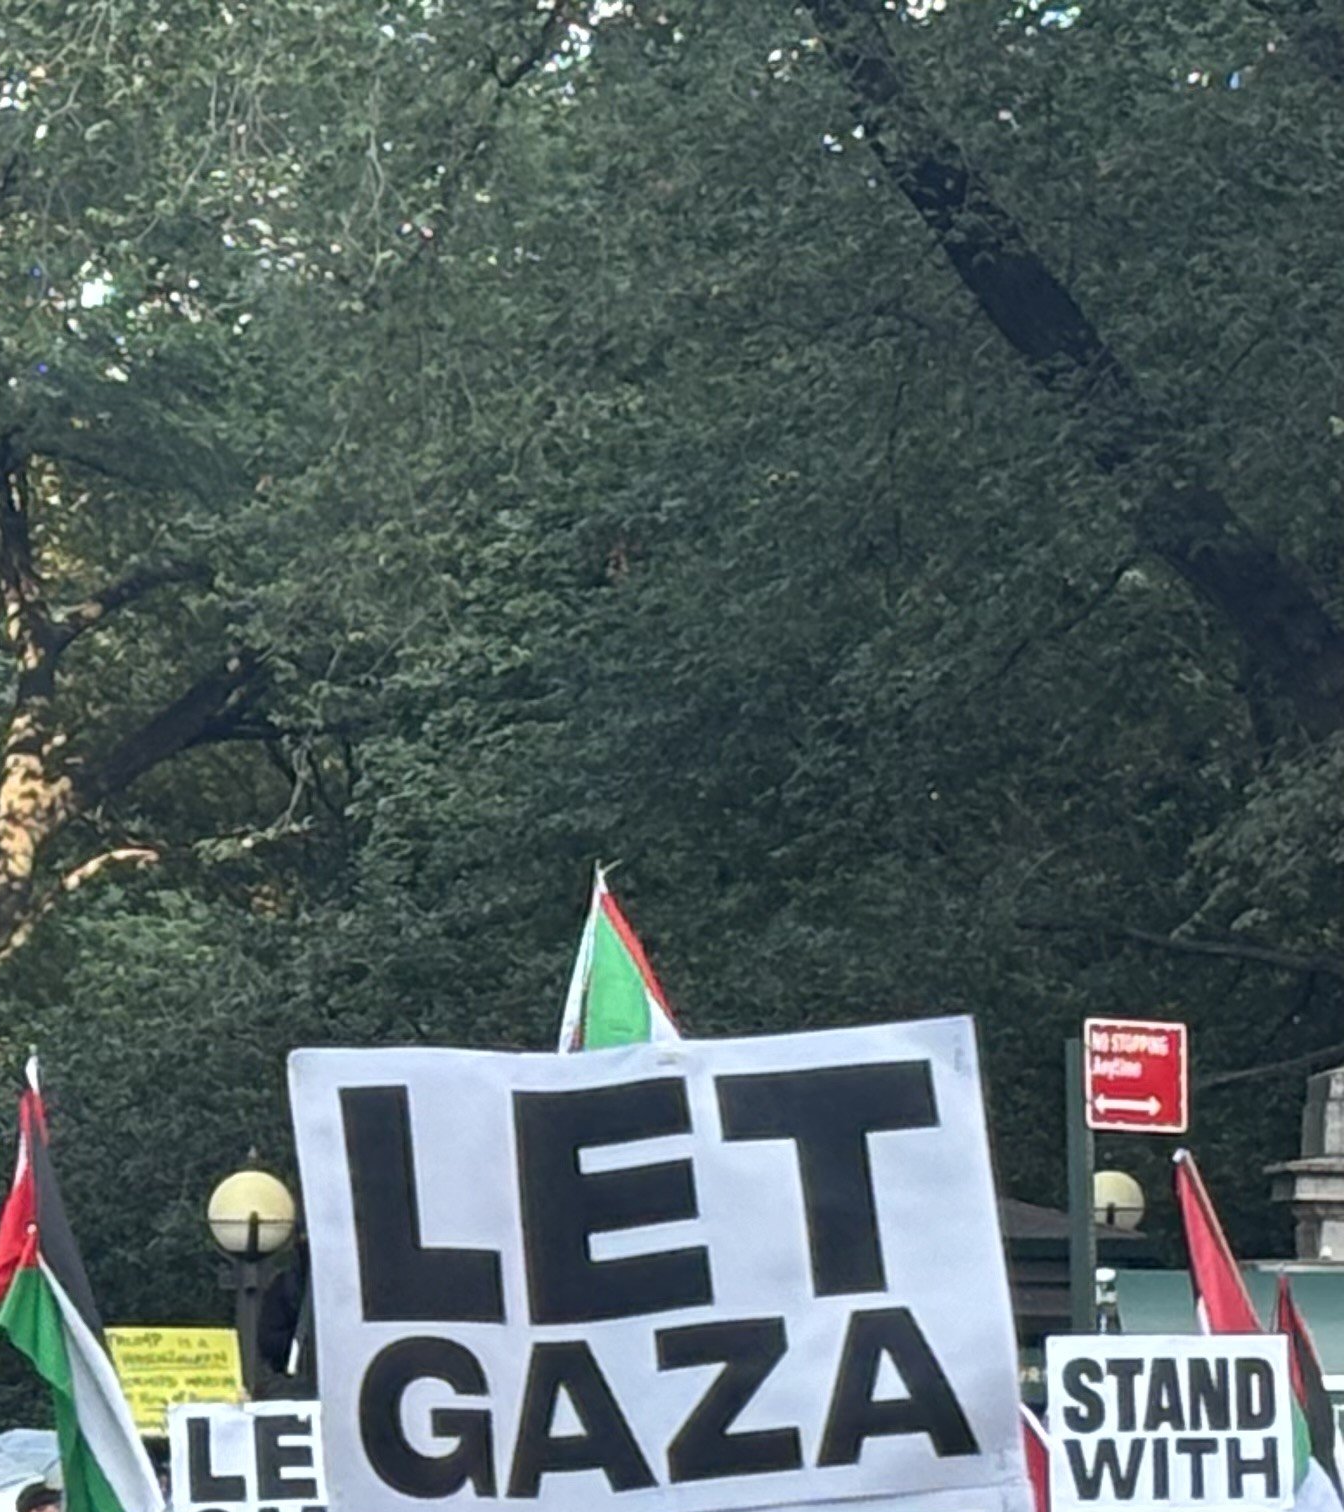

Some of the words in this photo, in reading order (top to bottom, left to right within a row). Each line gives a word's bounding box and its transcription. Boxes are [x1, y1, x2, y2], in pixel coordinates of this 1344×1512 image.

[1092, 1031, 1108, 1053] NO
[1111, 1033, 1169, 1056] STOPPING
[339, 1059, 940, 1323] LET
[358, 1306, 981, 1499] GAZA
[1062, 1356, 1276, 1433] STAND
[186, 1413, 318, 1503] LE
[1064, 1437, 1281, 1501] WITH
